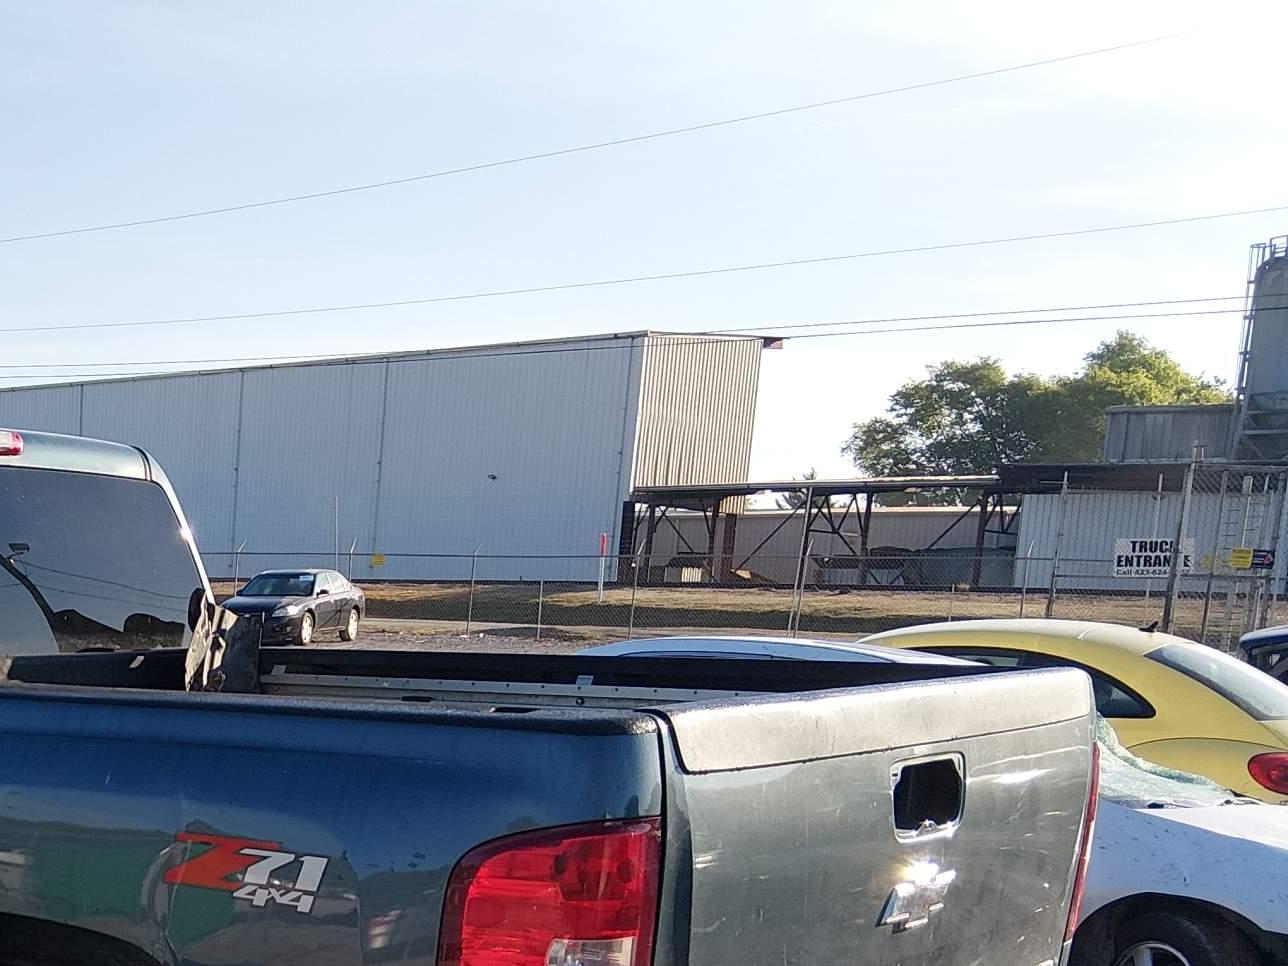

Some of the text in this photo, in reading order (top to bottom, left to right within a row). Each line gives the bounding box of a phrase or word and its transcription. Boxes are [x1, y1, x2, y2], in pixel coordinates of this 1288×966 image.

[1116, 554, 1192, 568] ENTRANE
[1116, 568, 1133, 576] Call
[162, 831, 329, 893] Z71
